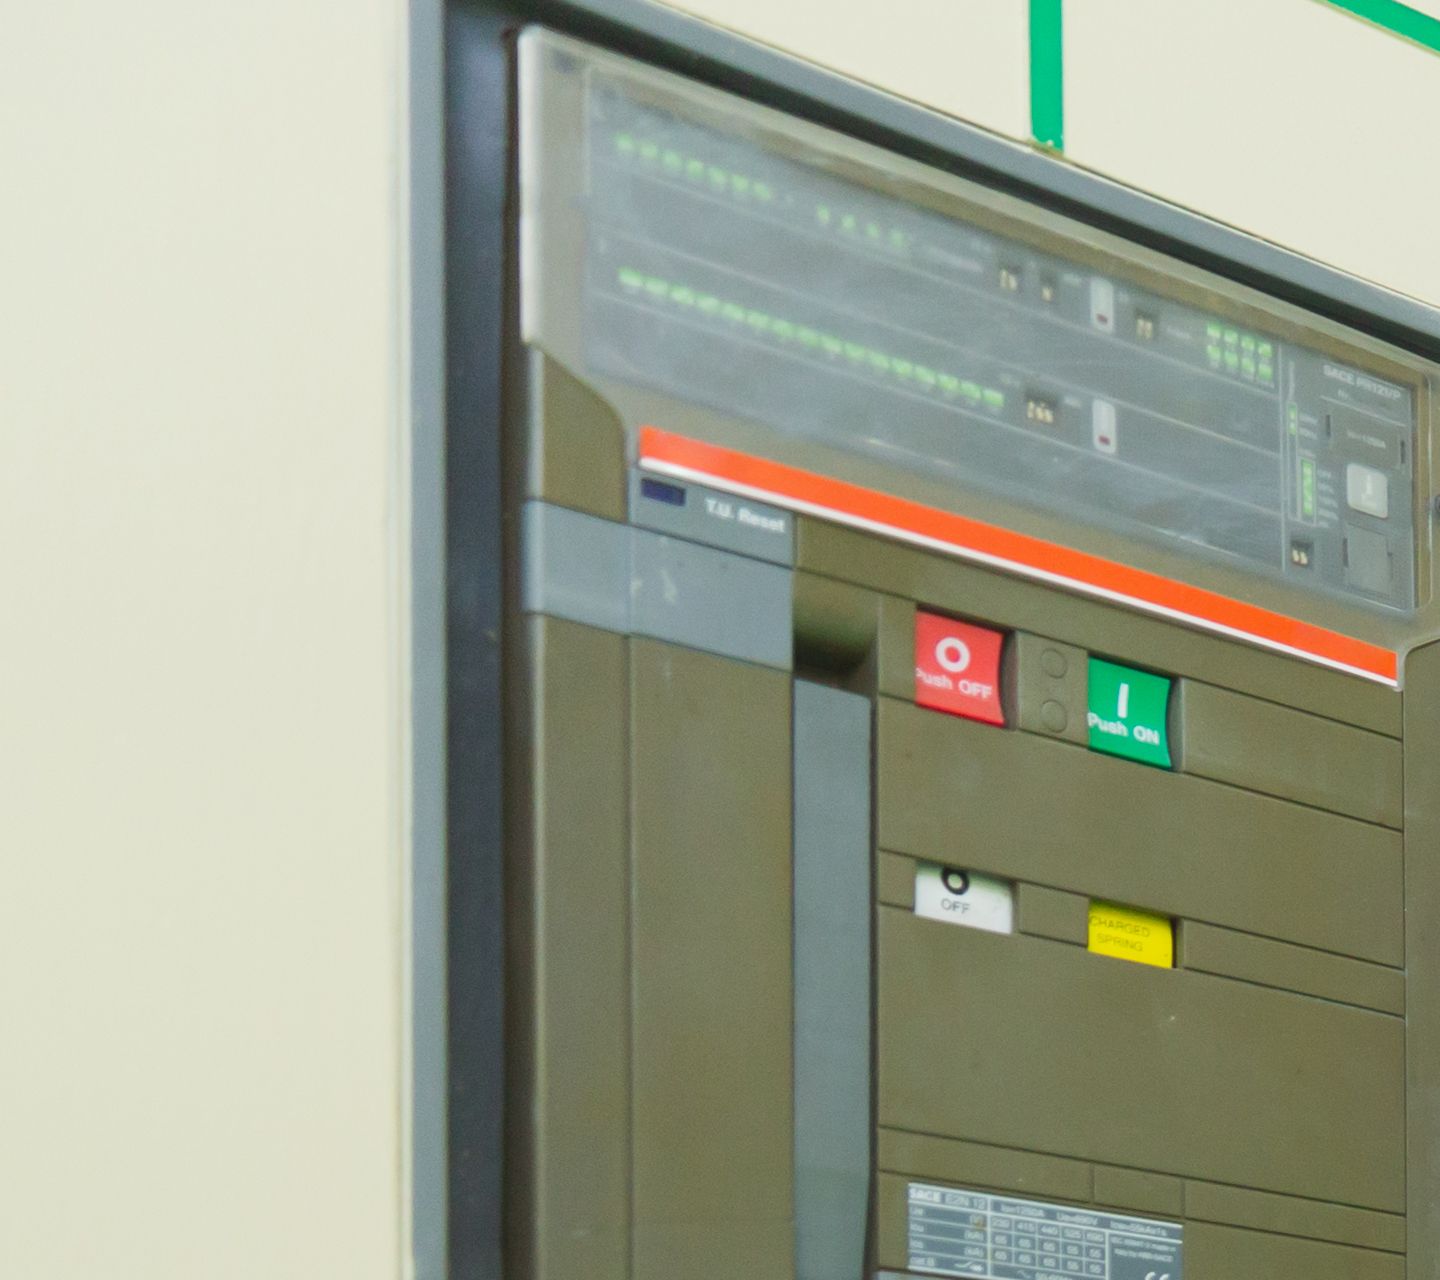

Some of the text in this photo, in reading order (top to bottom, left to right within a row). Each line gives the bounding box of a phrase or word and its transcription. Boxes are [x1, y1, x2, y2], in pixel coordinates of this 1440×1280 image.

[738, 507, 785, 533] Reset
[958, 679, 993, 699] OFF
[1087, 711, 1160, 746] Push ON
[941, 898, 970, 914] OFF
[1089, 915, 1151, 938] CHARGED
[1097, 933, 1143, 952] SPRING
